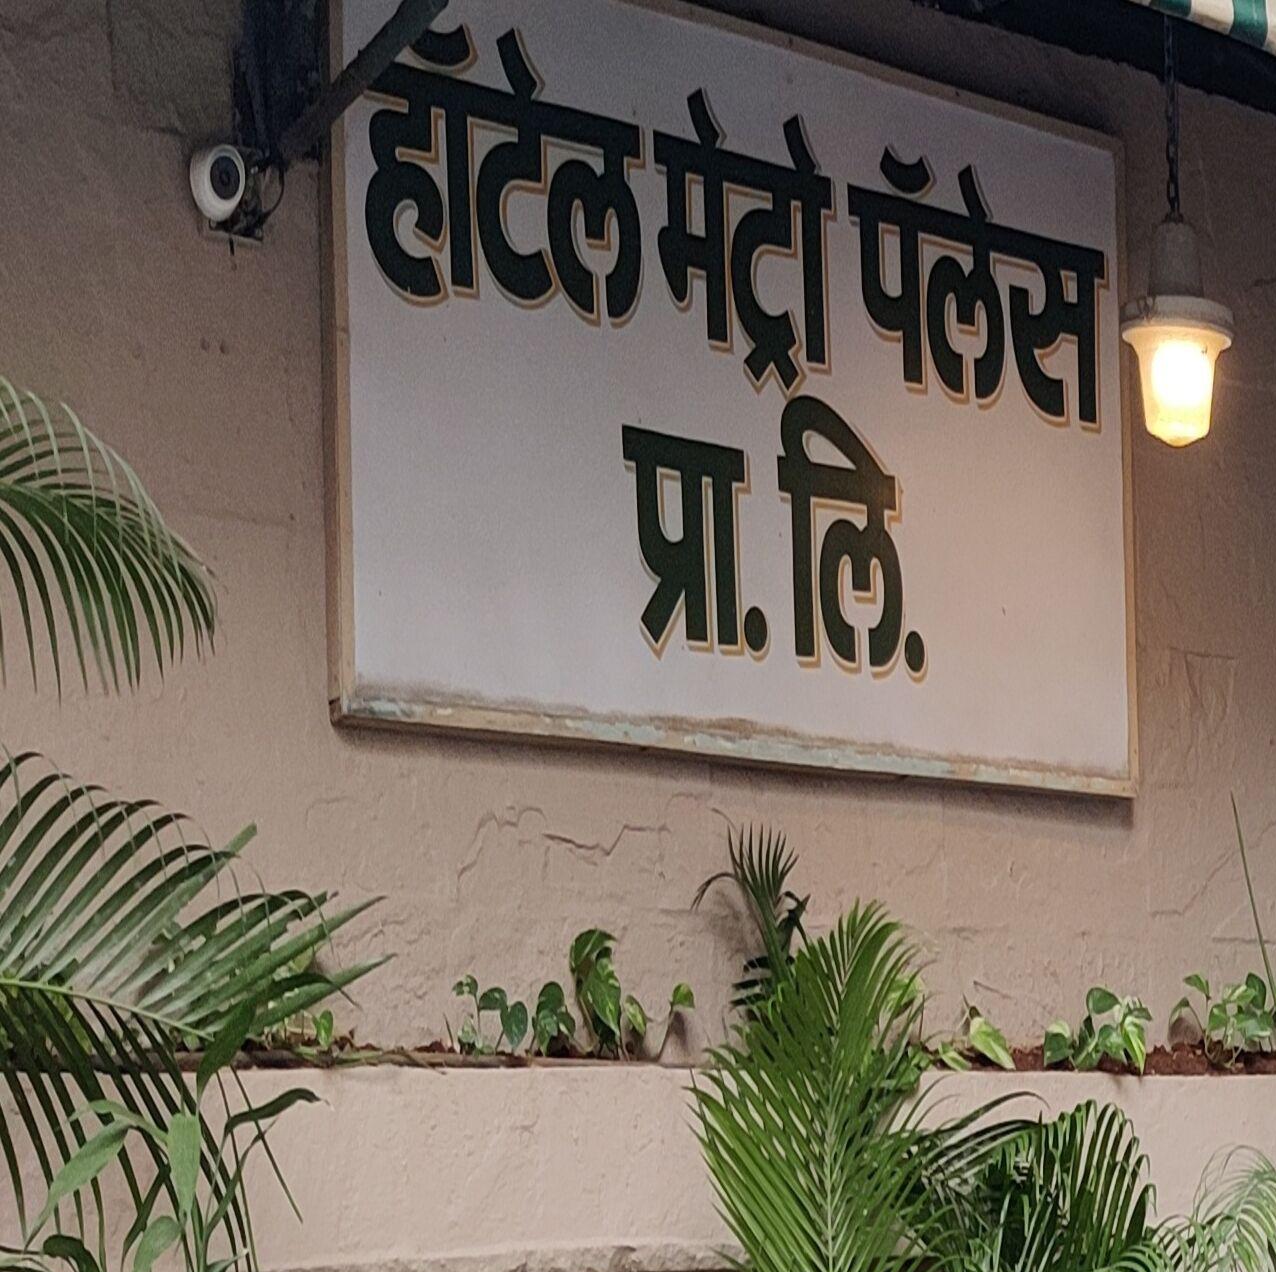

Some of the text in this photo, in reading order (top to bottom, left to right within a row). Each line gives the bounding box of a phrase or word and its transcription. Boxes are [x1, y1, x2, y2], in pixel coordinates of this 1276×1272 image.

[363, 22, 1109, 426] हॉटेल मेट्रो पॅलेस
[620, 394, 927, 676] प्रा. लि.
